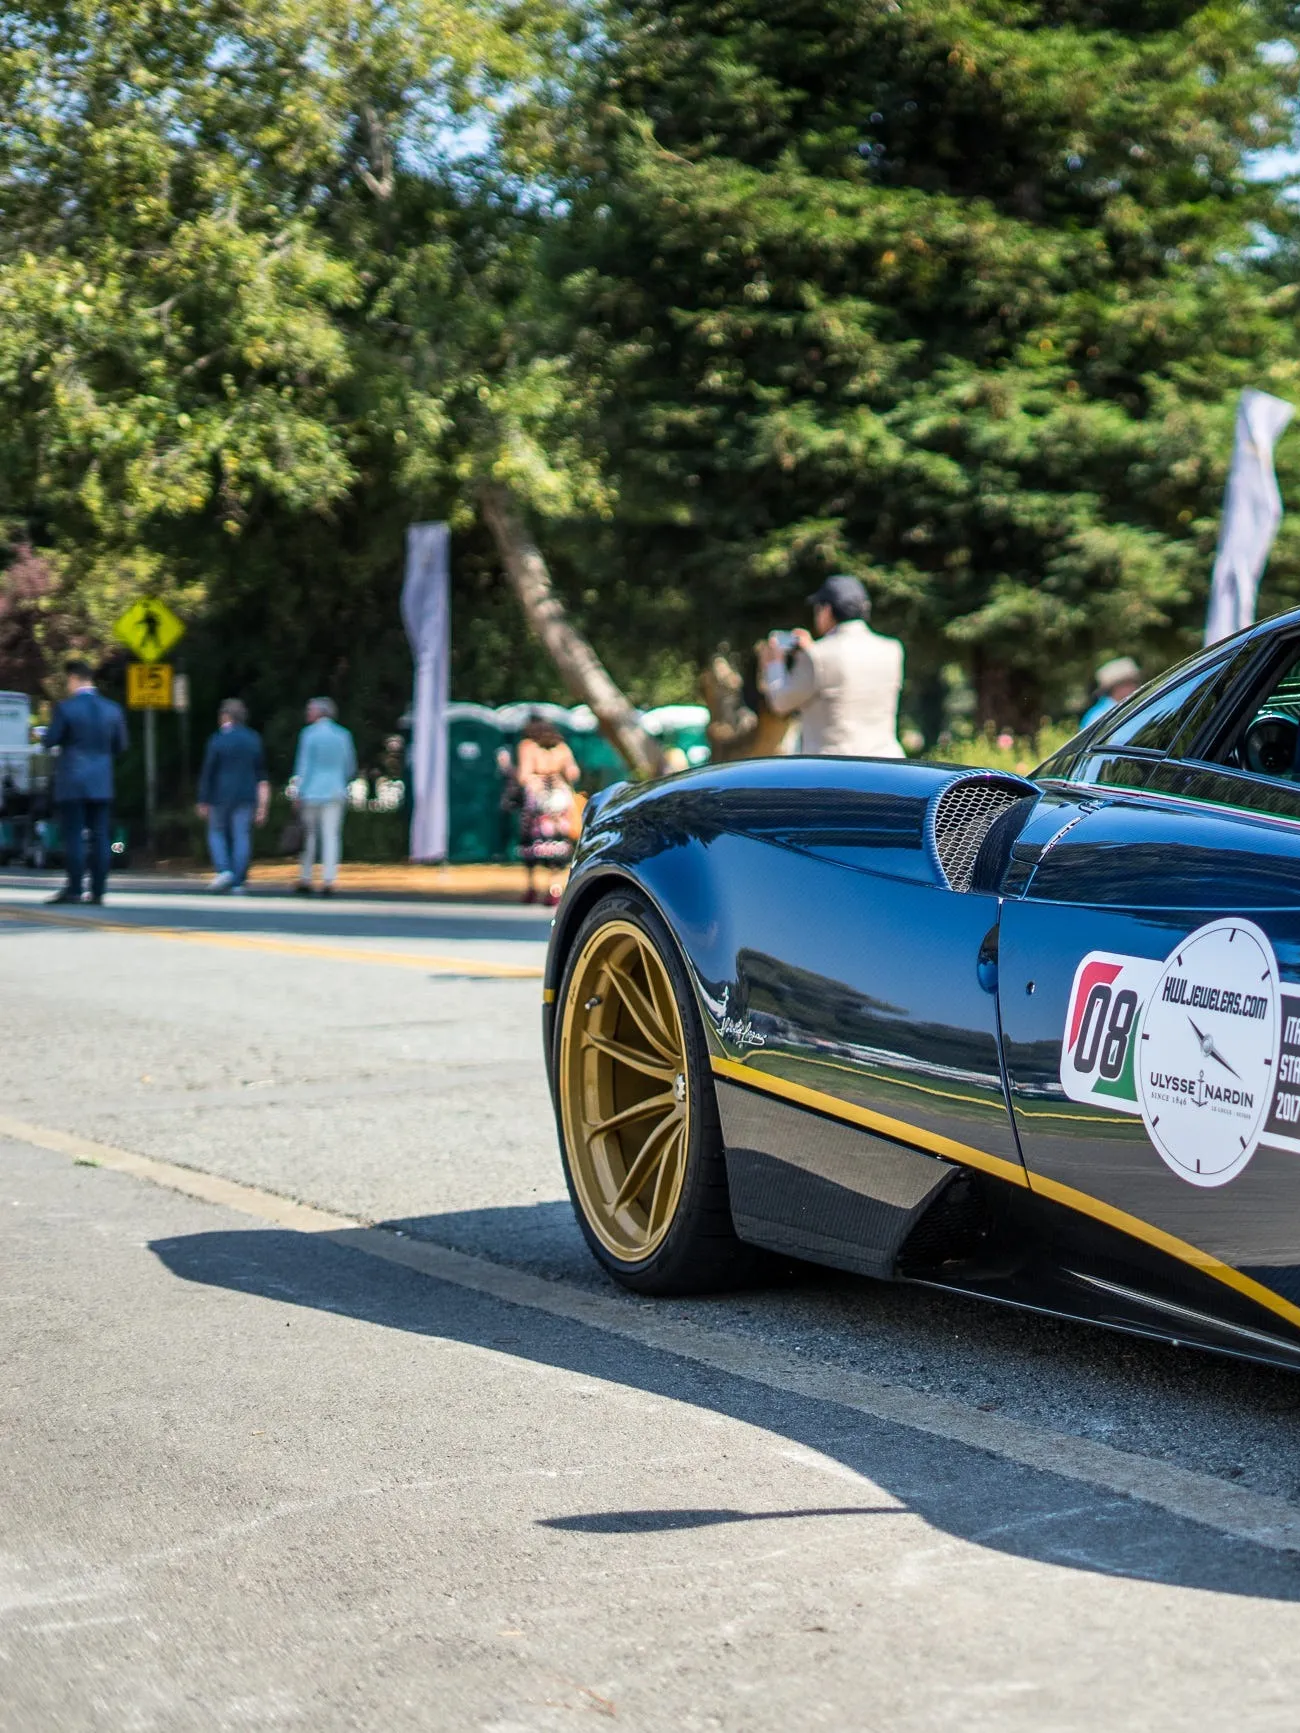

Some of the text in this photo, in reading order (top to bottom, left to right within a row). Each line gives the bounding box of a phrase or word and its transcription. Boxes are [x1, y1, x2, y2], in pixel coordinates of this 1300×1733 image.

[1161, 976, 1268, 1020] HWLJEWELERS.COM
[1073, 984, 1138, 1080] 08
[1150, 1071, 1254, 1108] ULYSSE NARDIN
[1151, 1091, 1187, 1107] SINCE 1846
